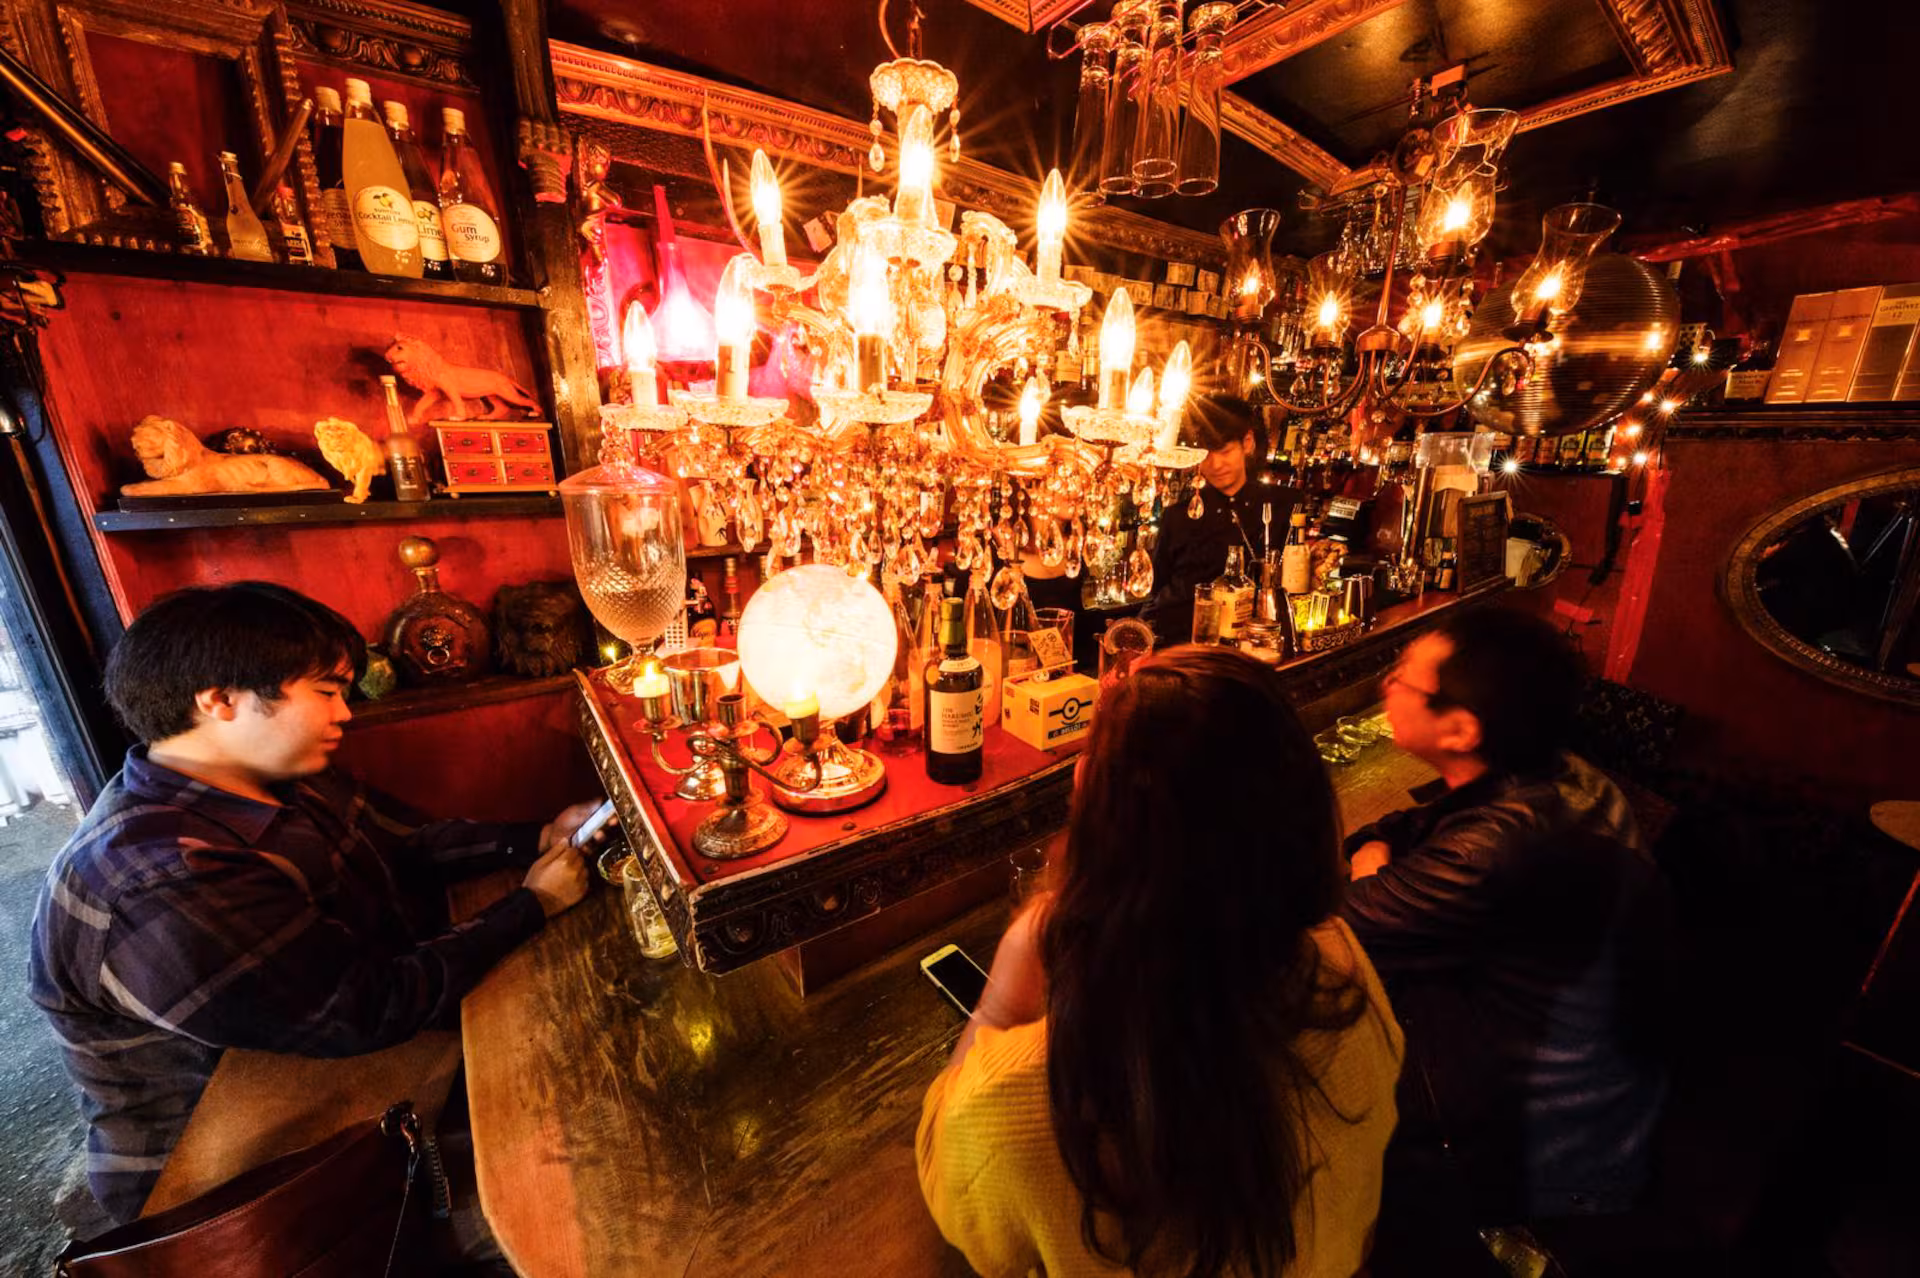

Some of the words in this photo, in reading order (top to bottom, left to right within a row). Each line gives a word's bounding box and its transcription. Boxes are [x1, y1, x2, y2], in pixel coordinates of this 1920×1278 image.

[416, 224, 444, 237] Lime
[451, 223, 477, 234] Gum
[464, 234, 490, 244] syrup
